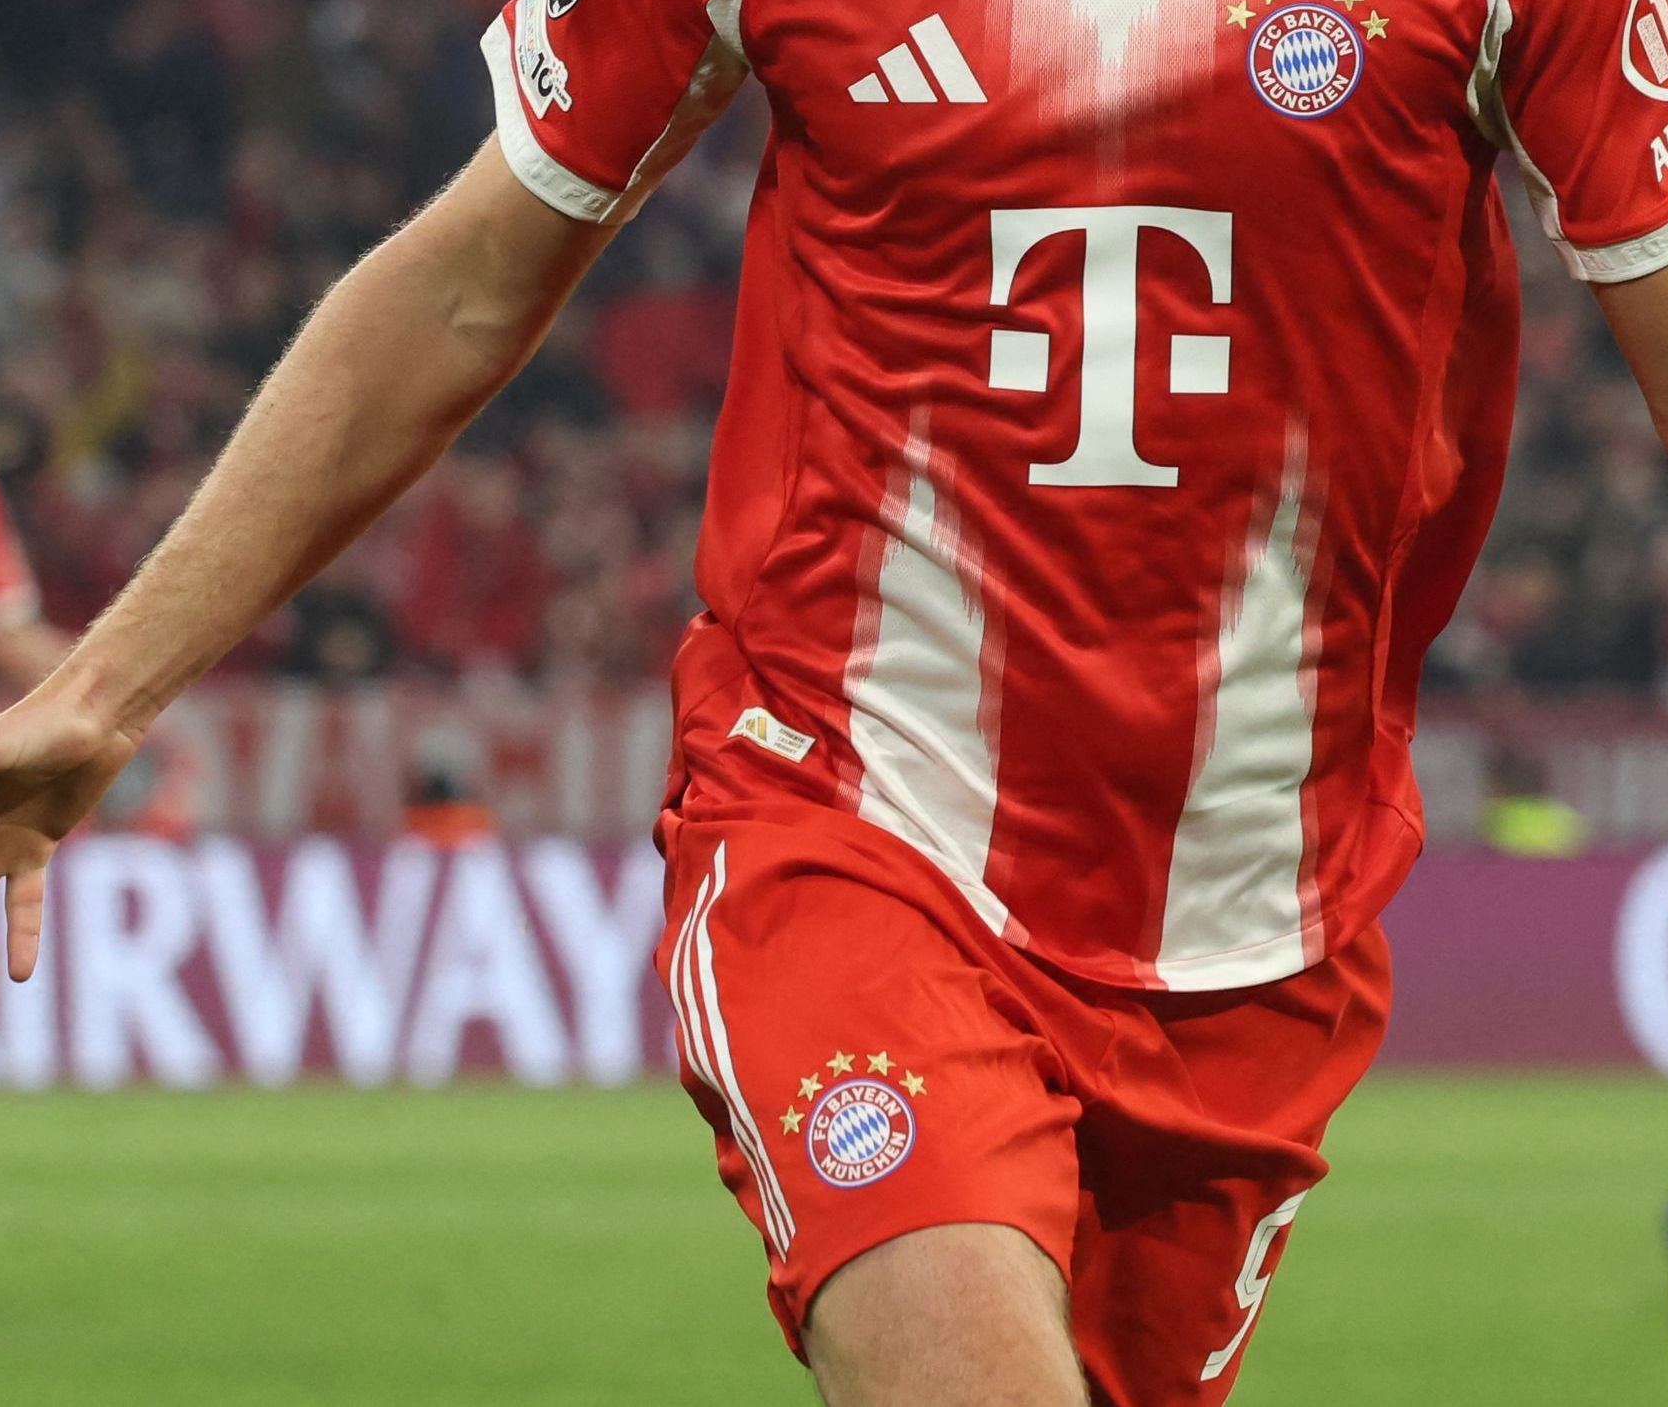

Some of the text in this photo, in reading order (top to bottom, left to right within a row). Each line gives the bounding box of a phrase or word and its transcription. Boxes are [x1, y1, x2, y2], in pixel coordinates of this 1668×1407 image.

[1259, 12, 1354, 57] FC BAYERN
[1258, 67, 1350, 111] MÜNCHEN
[988, 205, 1233, 488] T
[813, 1087, 902, 1141] FC BAYERN
[821, 1131, 906, 1180] MÜNCHEN
